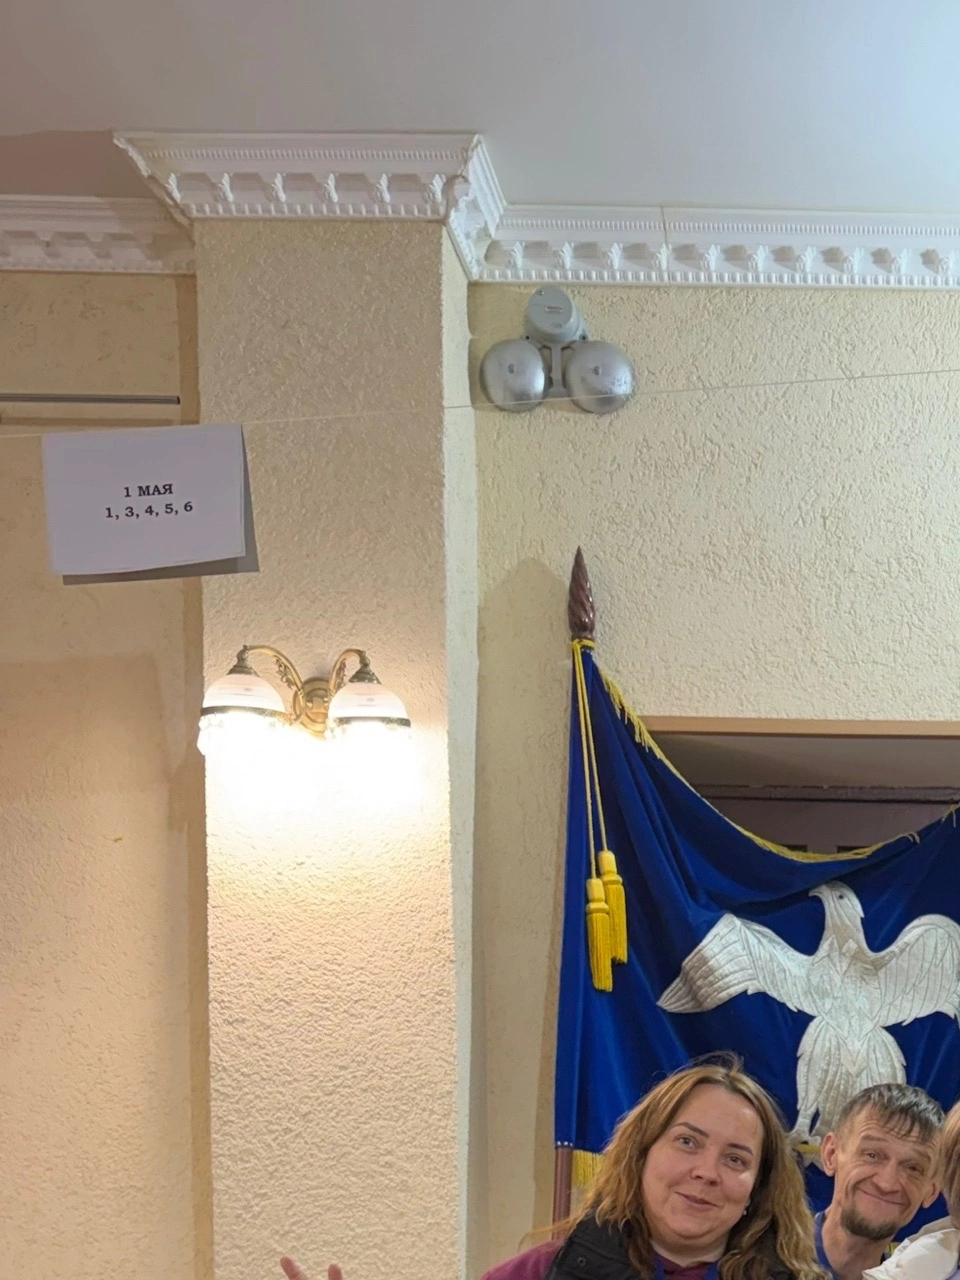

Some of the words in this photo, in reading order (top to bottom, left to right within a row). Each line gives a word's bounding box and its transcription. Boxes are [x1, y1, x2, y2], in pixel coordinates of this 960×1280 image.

[123, 486, 132, 498] 1
[137, 483, 174, 497] МАЯ
[105, 507, 120, 520] 1,
[125, 506, 140, 519] 3,
[145, 505, 159, 518] 4,
[164, 503, 179, 516] 5,
[183, 501, 193, 513] 6
